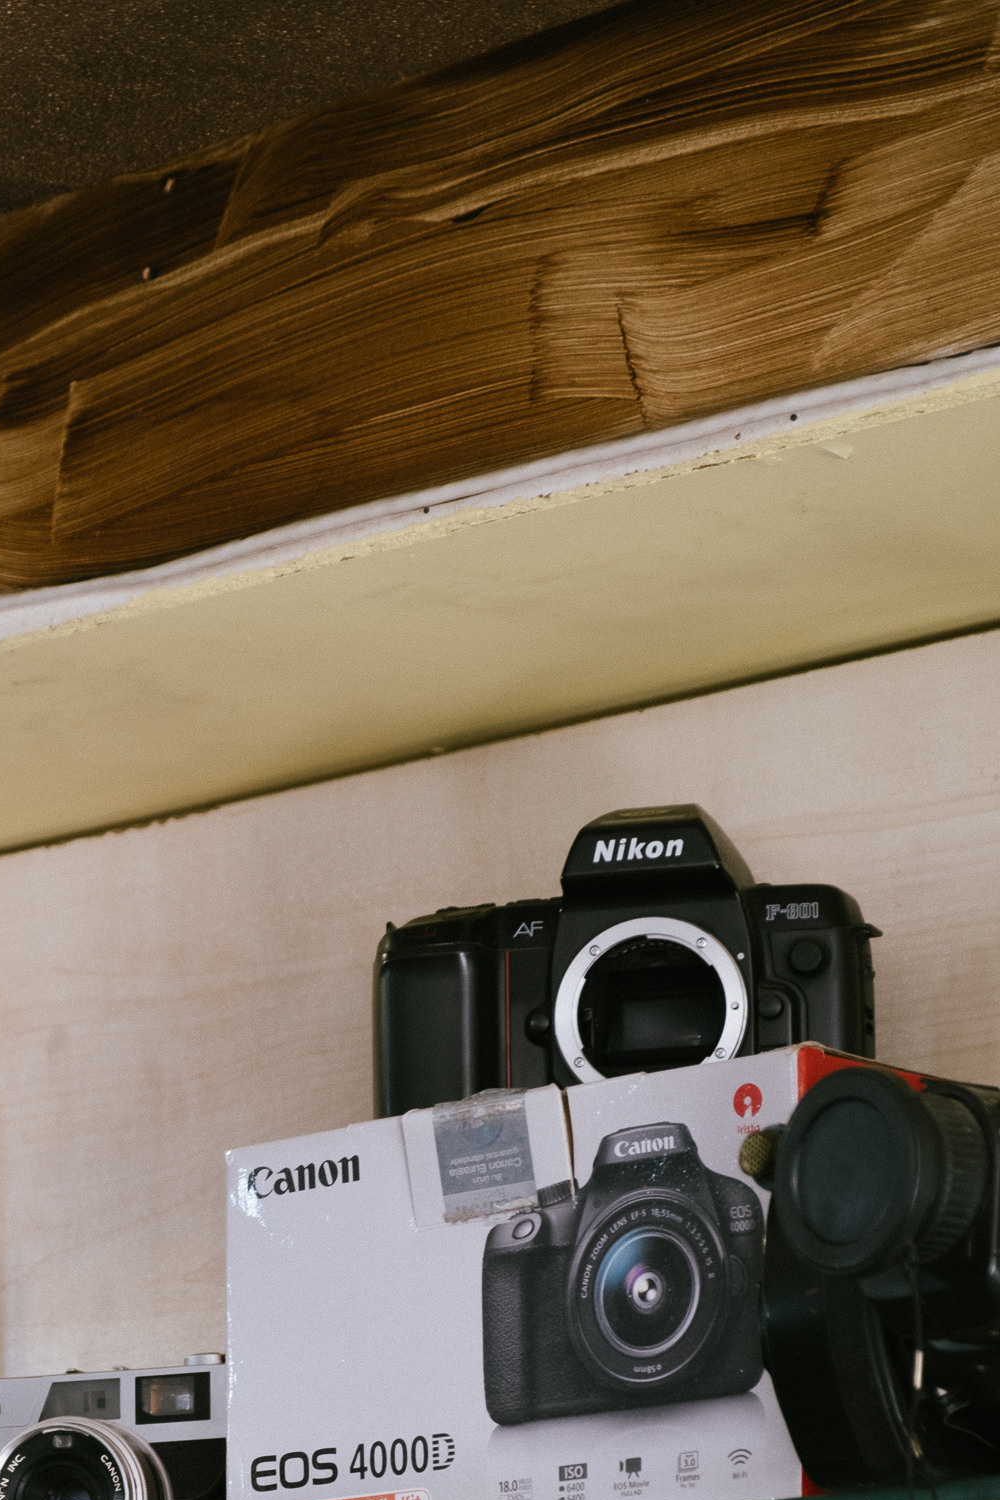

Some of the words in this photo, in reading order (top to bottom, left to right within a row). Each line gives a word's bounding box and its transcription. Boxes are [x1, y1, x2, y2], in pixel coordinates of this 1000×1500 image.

[593, 837, 684, 863] Nikon
[765, 902, 819, 921] F-801
[513, 920, 544, 938] AF
[614, 1135, 675, 1158] Canon
[448, 1164, 487, 1178] Eurasia
[488, 1157, 522, 1171] Canon
[247, 1154, 360, 1199] Canon
[730, 1205, 752, 1218] EOS
[580, 1264, 593, 1299] CANON
[590, 1233, 608, 1261] ZOOM
[609, 1217, 628, 1234] LENS
[631, 1209, 647, 1221] EF-S
[650, 1208, 683, 1224] 18-55mm
[251, 1447, 339, 1493] EOS
[350, 1433, 456, 1480] 4000D
[100, 1454, 123, 1493] CANON
[563, 1466, 584, 1480] ISO
[675, 1473, 700, 1484] Frames
[498, 1479, 518, 1493] 18.0
[566, 1482, 585, 1492] 6400
[613, 1482, 627, 1491] EOS
[628, 1480, 650, 1489] Movie
